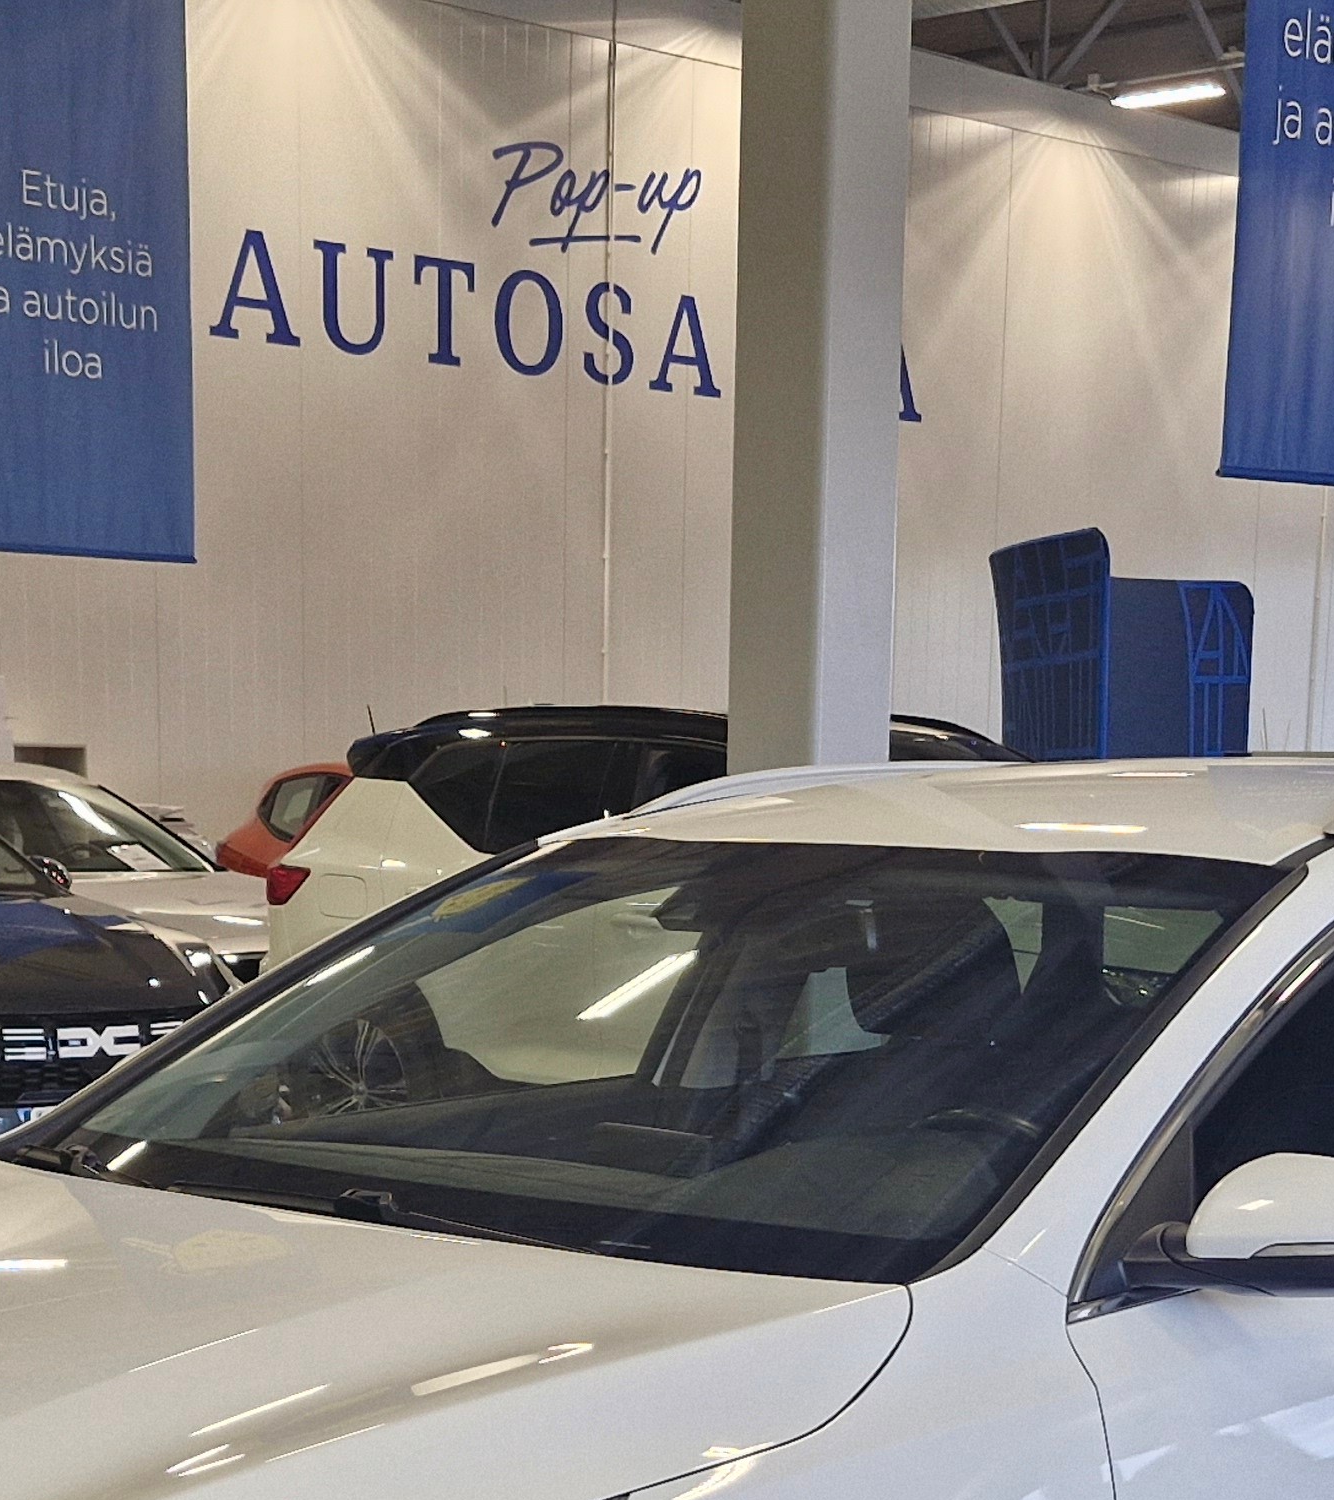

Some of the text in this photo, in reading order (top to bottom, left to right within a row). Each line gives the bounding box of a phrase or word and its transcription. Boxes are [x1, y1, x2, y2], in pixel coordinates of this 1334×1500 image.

[1272, 84, 1302, 146] ja
[21, 169, 116, 222] Etuja,
[492, 141, 702, 255] Pop-up
[22, 287, 158, 333] autoilun
[209, 228, 922, 424] AUTOSA
[43, 338, 104, 380] iloa
